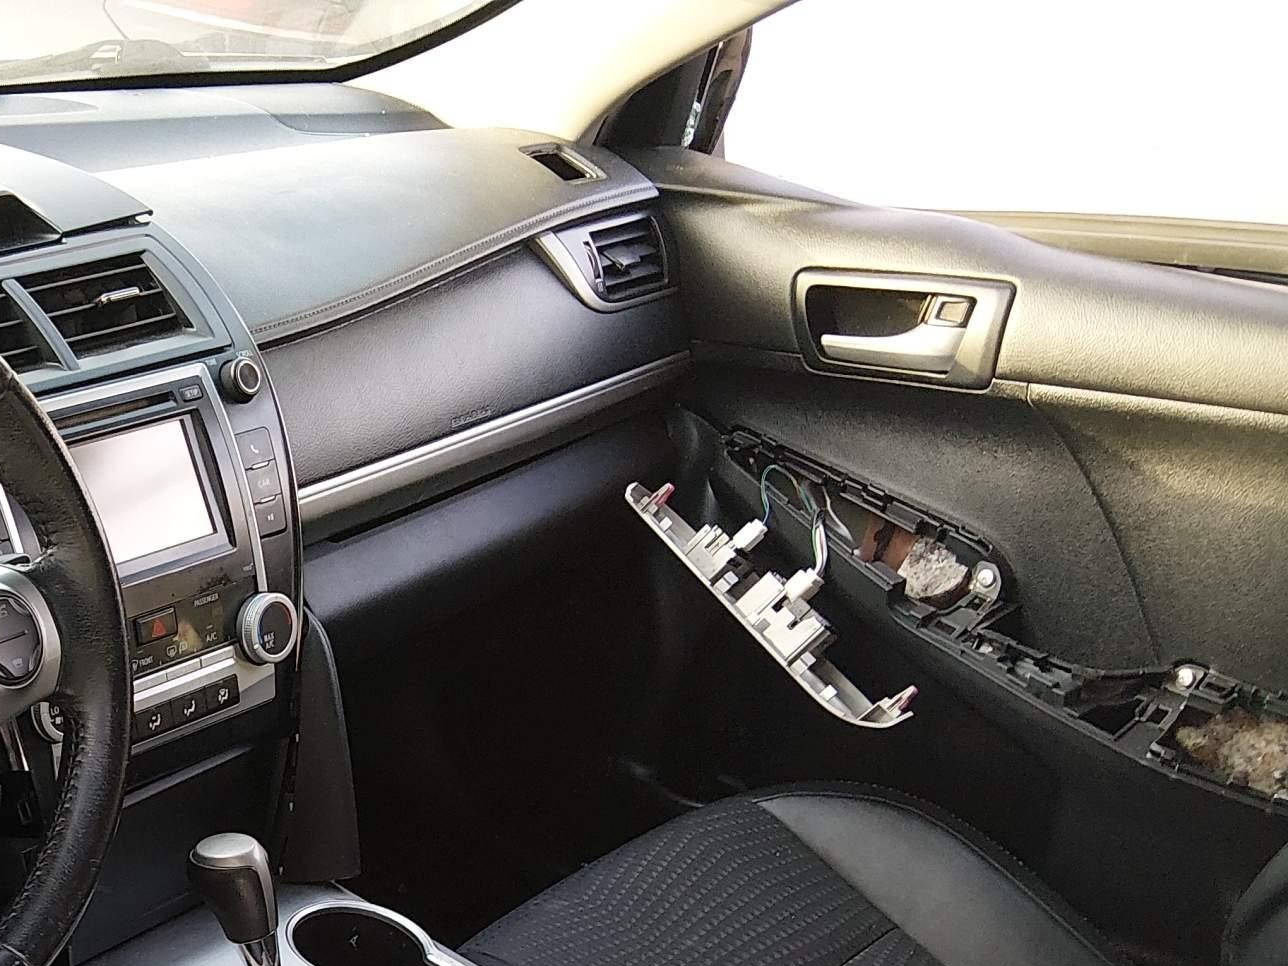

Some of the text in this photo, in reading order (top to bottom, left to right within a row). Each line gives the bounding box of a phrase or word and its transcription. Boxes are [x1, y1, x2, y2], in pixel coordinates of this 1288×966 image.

[206, 632, 218, 643] A/C
[263, 631, 275, 642] MAX
[265, 640, 275, 650] A/C
